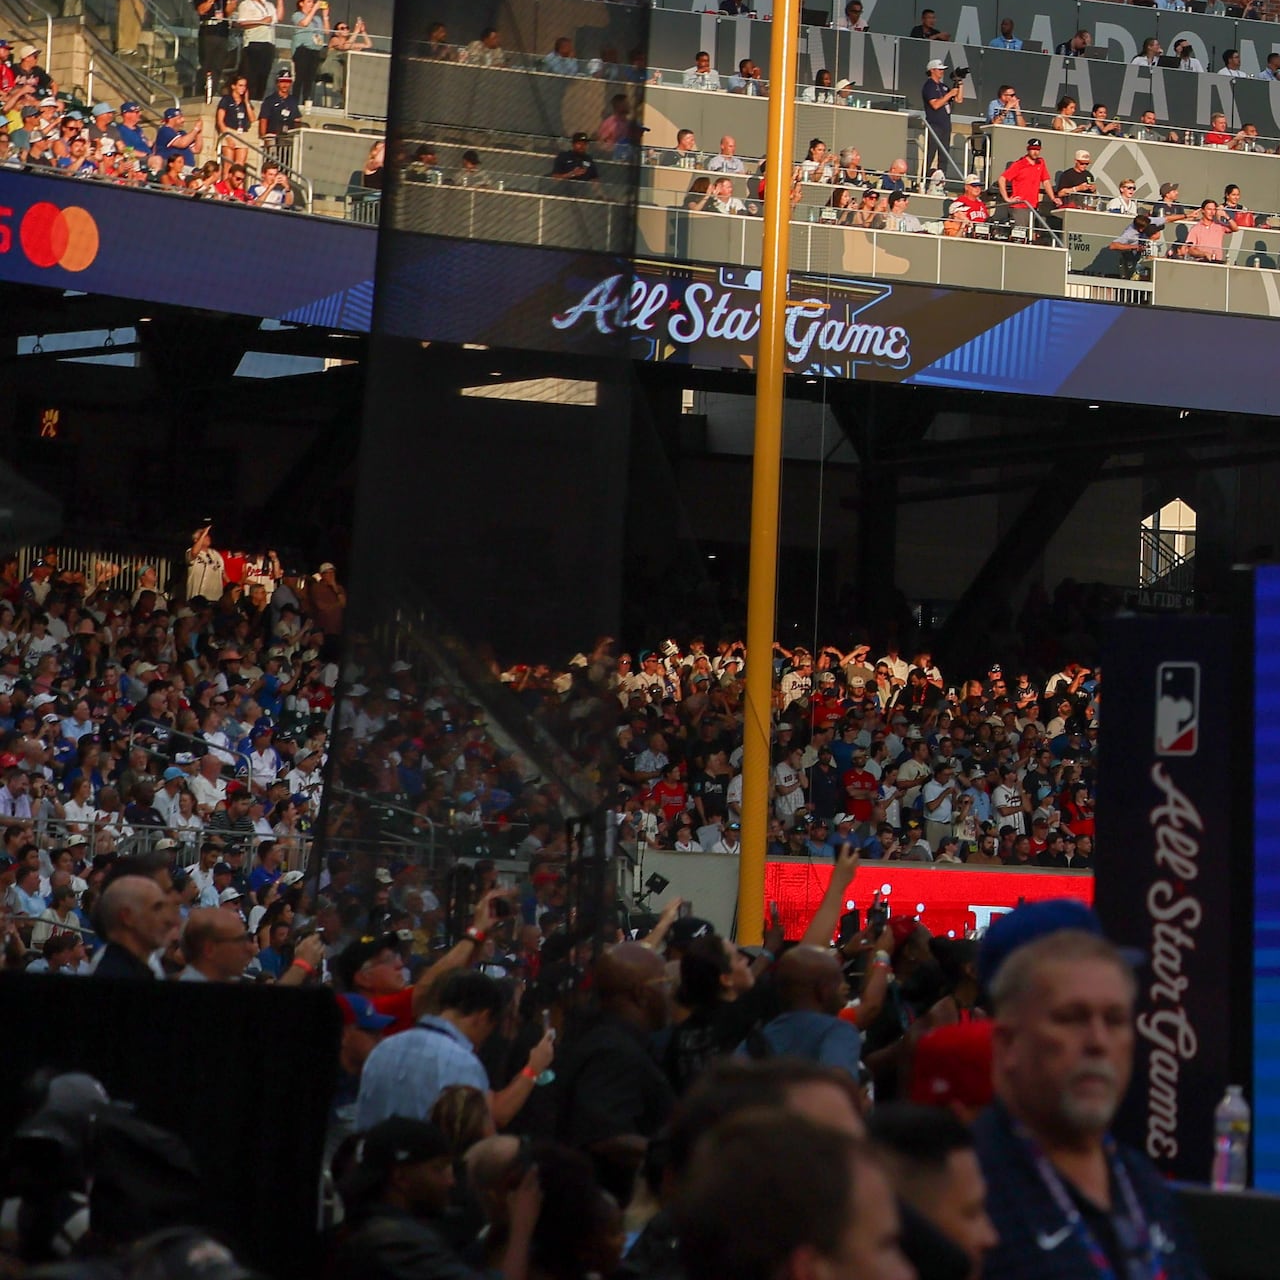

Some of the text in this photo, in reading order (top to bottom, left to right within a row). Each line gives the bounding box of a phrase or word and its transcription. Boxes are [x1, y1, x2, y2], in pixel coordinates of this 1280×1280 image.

[552, 274, 667, 334] All
[1138, 764, 1202, 1160] All Star Game
